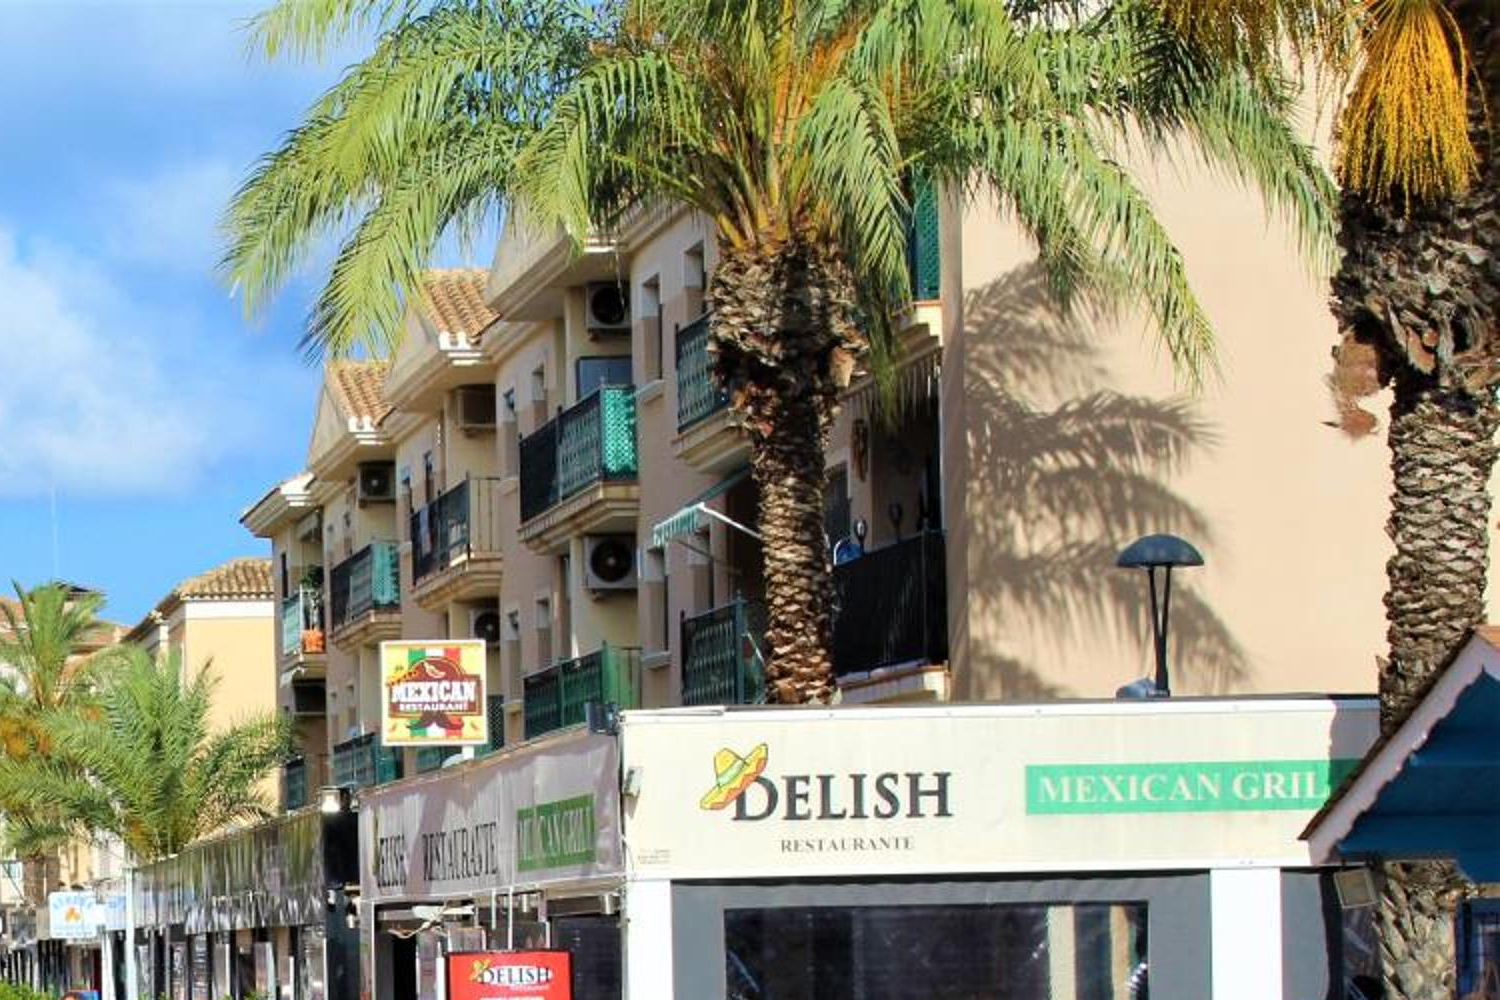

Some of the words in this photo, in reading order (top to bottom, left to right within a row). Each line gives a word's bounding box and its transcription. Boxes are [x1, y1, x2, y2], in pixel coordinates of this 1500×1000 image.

[391, 680, 476, 703] MEXICAN
[399, 702, 469, 712] RESTAURANT
[731, 771, 955, 822] DELISH
[1037, 772, 1222, 804] MEXICAN
[421, 820, 500, 881] RESTAURANTE
[780, 836, 916, 853] RESTAURANTE
[477, 966, 550, 985] DELISH
